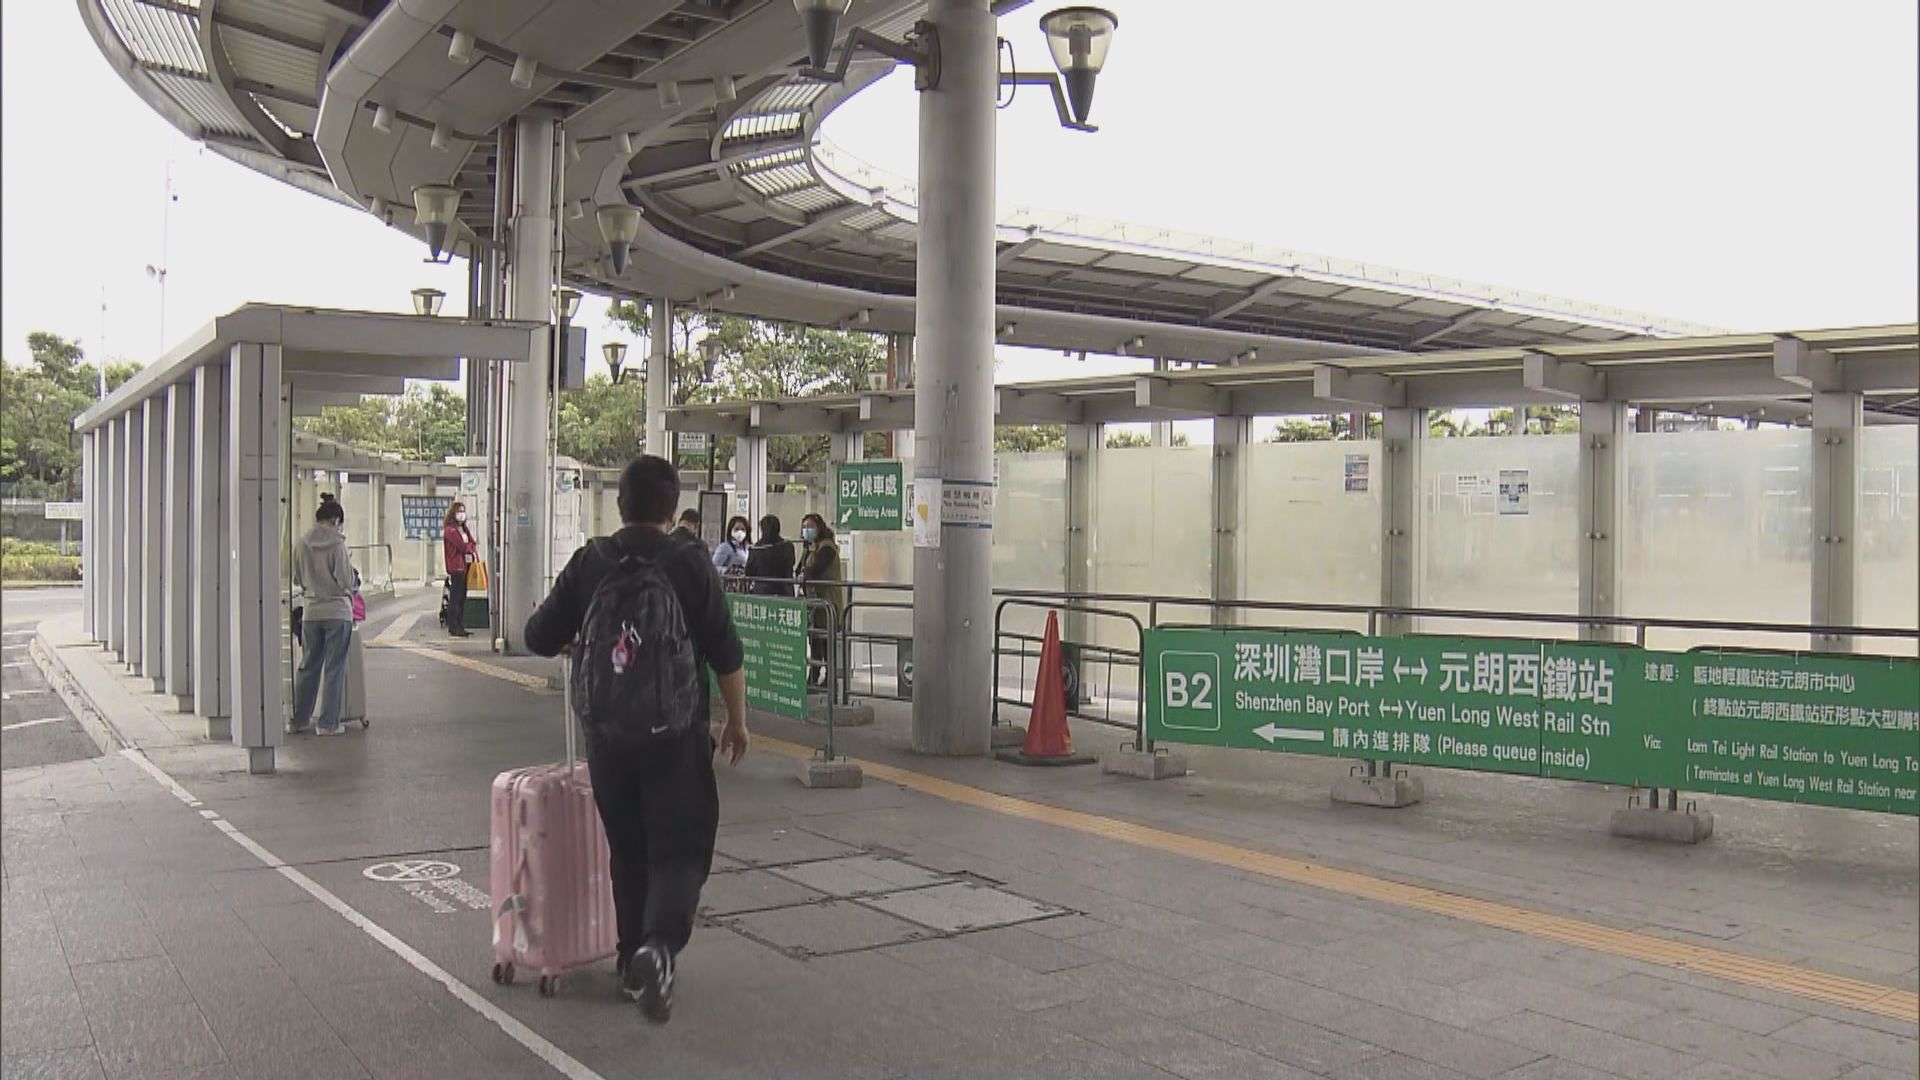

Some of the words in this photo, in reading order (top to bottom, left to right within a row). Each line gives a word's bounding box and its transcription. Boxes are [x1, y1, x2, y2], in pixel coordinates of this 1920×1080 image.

[841, 480, 858, 497] B2
[858, 506, 879, 519] Waiting
[880, 506, 898, 518] Areas
[1166, 671, 1213, 710] B2
[1233, 642, 1384, 688] 深圳灣口岸
[1440, 651, 1614, 705] 元朗西鐵站
[1235, 691, 1301, 714] Shenzhen
[1306, 695, 1333, 718] Bay
[1339, 696, 1370, 717] Port
[1406, 699, 1446, 723] Yuen
[1452, 703, 1491, 728] Long
[1496, 705, 1539, 730] West
[1544, 711, 1575, 734] Rail
[1581, 713, 1611, 737] Stn
[1333, 727, 1430, 754] 請內進排隊
[1437, 732, 1488, 757] (Please
[1493, 739, 1537, 762] queue
[1541, 743, 1591, 769] inside)
[1687, 738, 1708, 753] Lam
[1712, 740, 1727, 756] Tei
[1732, 741, 1755, 760] Light
[1760, 744, 1778, 760] Rail
[1783, 746, 1818, 764] Station
[1823, 750, 1834, 764] to
[1840, 751, 1867, 767] Yuen
[1872, 753, 1899, 773] Long
[1743, 771, 1753, 784] at
[1757, 772, 1780, 788] Yuen
[1783, 774, 1805, 793] Long
[1809, 776, 1833, 793] West
[1837, 778, 1854, 794] Rail
[1858, 781, 1890, 798] Station
[1895, 785, 1917, 800] near
